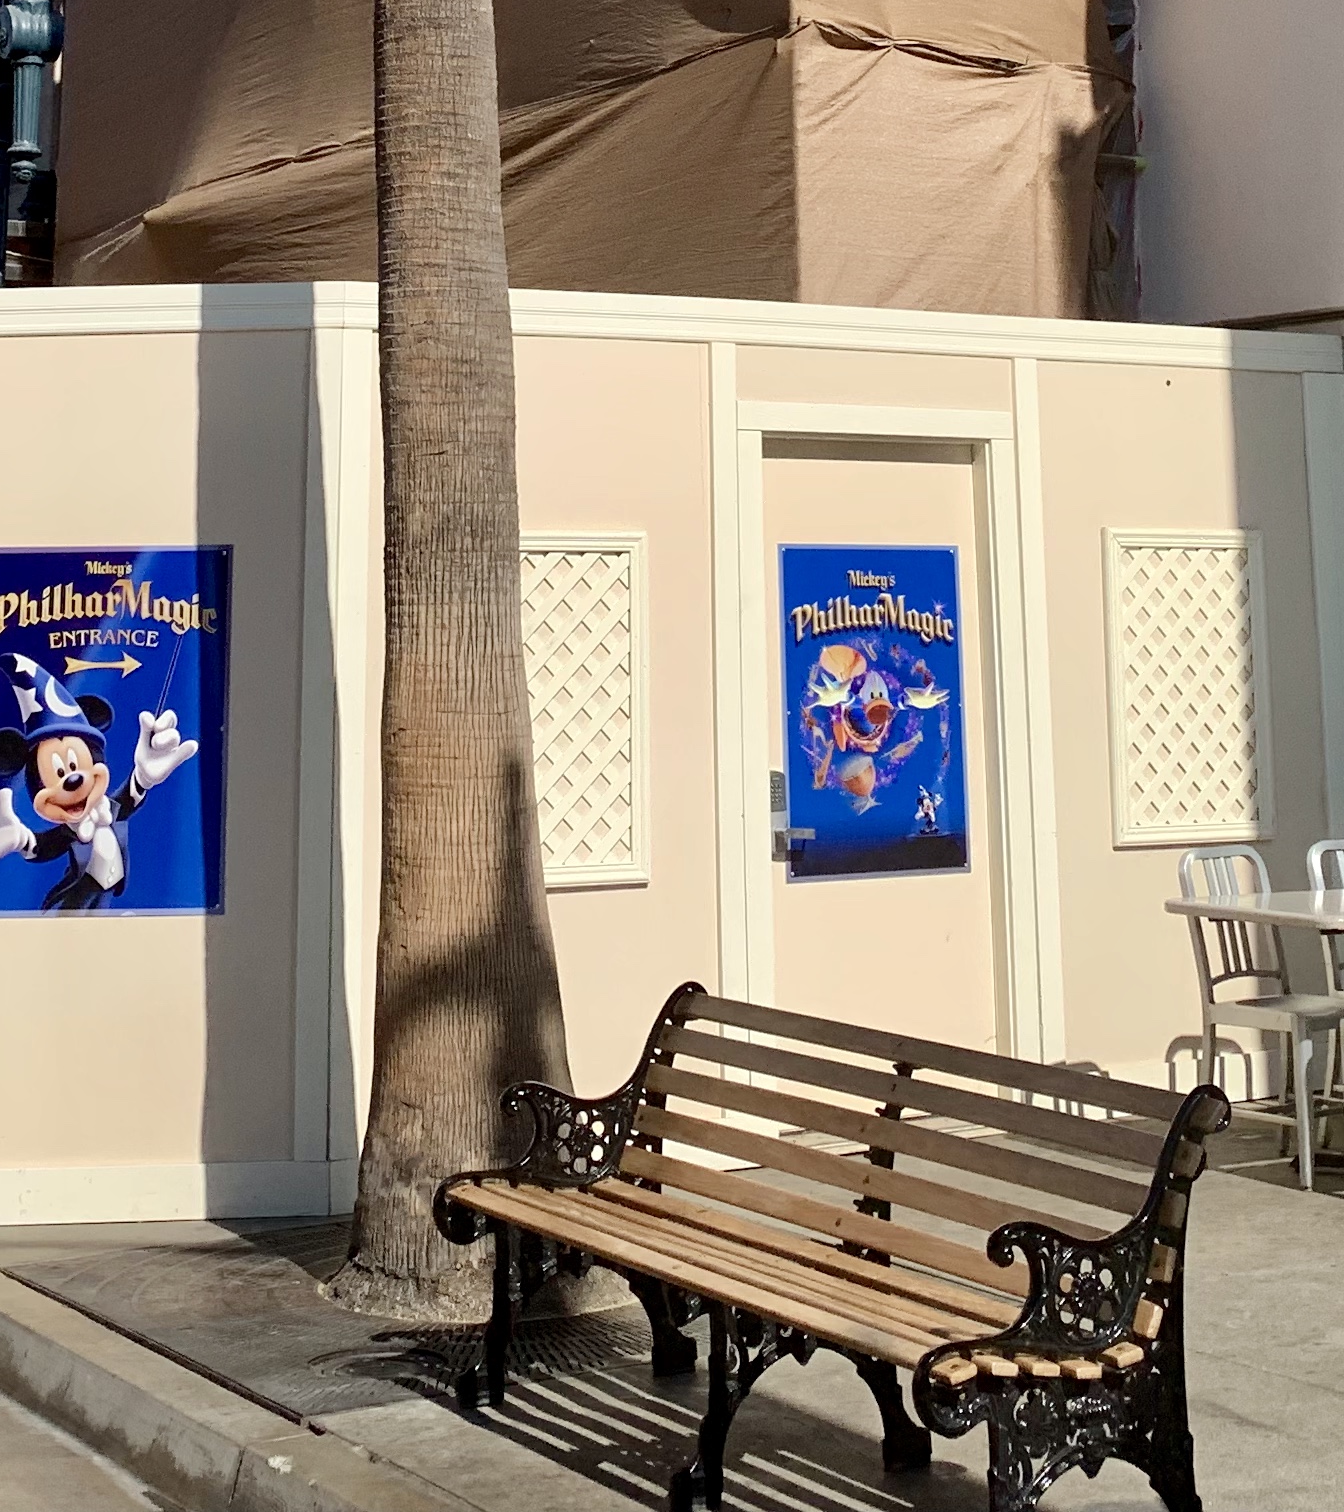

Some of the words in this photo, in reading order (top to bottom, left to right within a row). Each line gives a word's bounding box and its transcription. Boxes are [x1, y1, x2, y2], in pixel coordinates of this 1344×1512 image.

[84, 560, 133, 578] Mickey's
[847, 569, 896, 591] Mickey's
[790, 592, 955, 644] PhilharMagic
[48, 628, 160, 650] ENTRANCE
